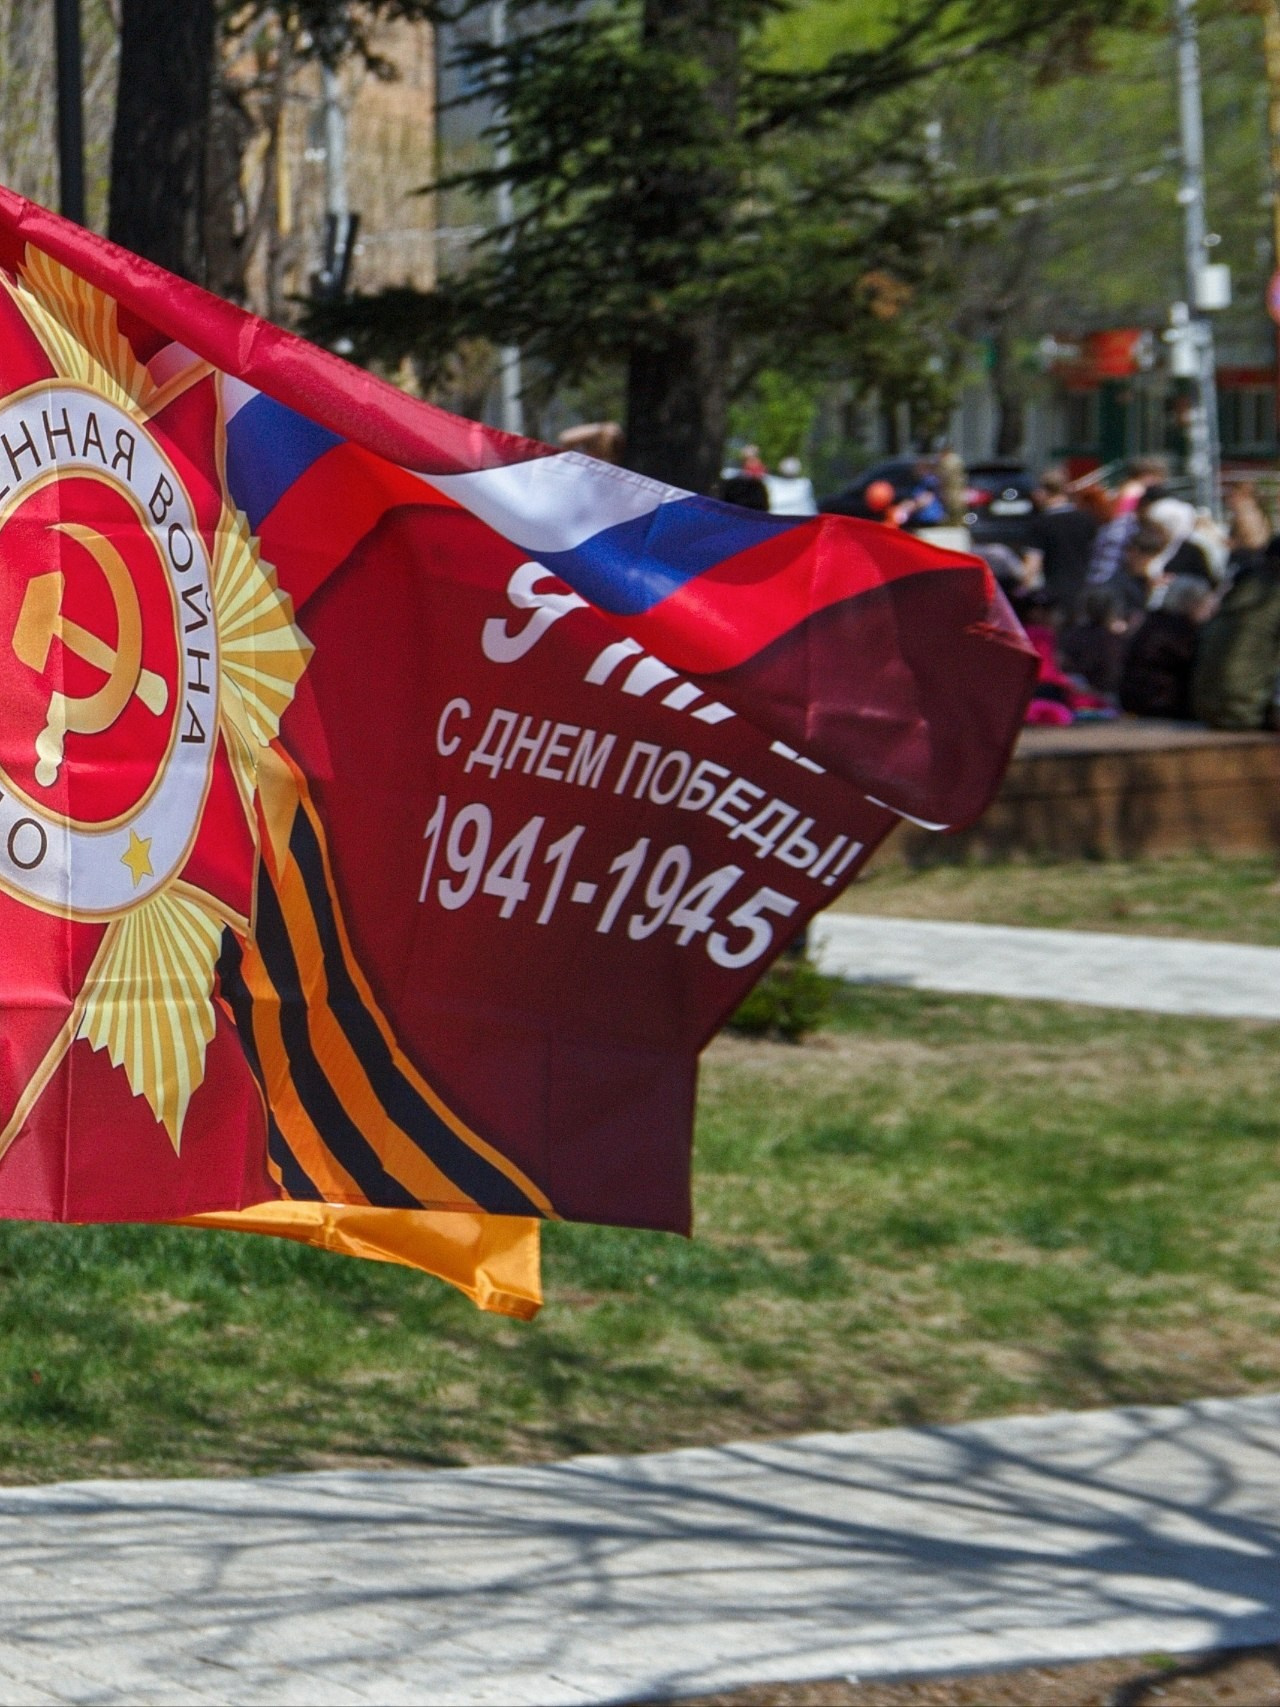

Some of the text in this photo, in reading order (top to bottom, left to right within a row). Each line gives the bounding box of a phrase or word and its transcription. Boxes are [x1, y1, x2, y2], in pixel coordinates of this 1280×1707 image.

[148, 473, 211, 745] ВОЙНА
[418, 795, 800, 970] 1941-1945
[436, 698, 864, 888] С ДНЕМ ПОБЕДЫ!
